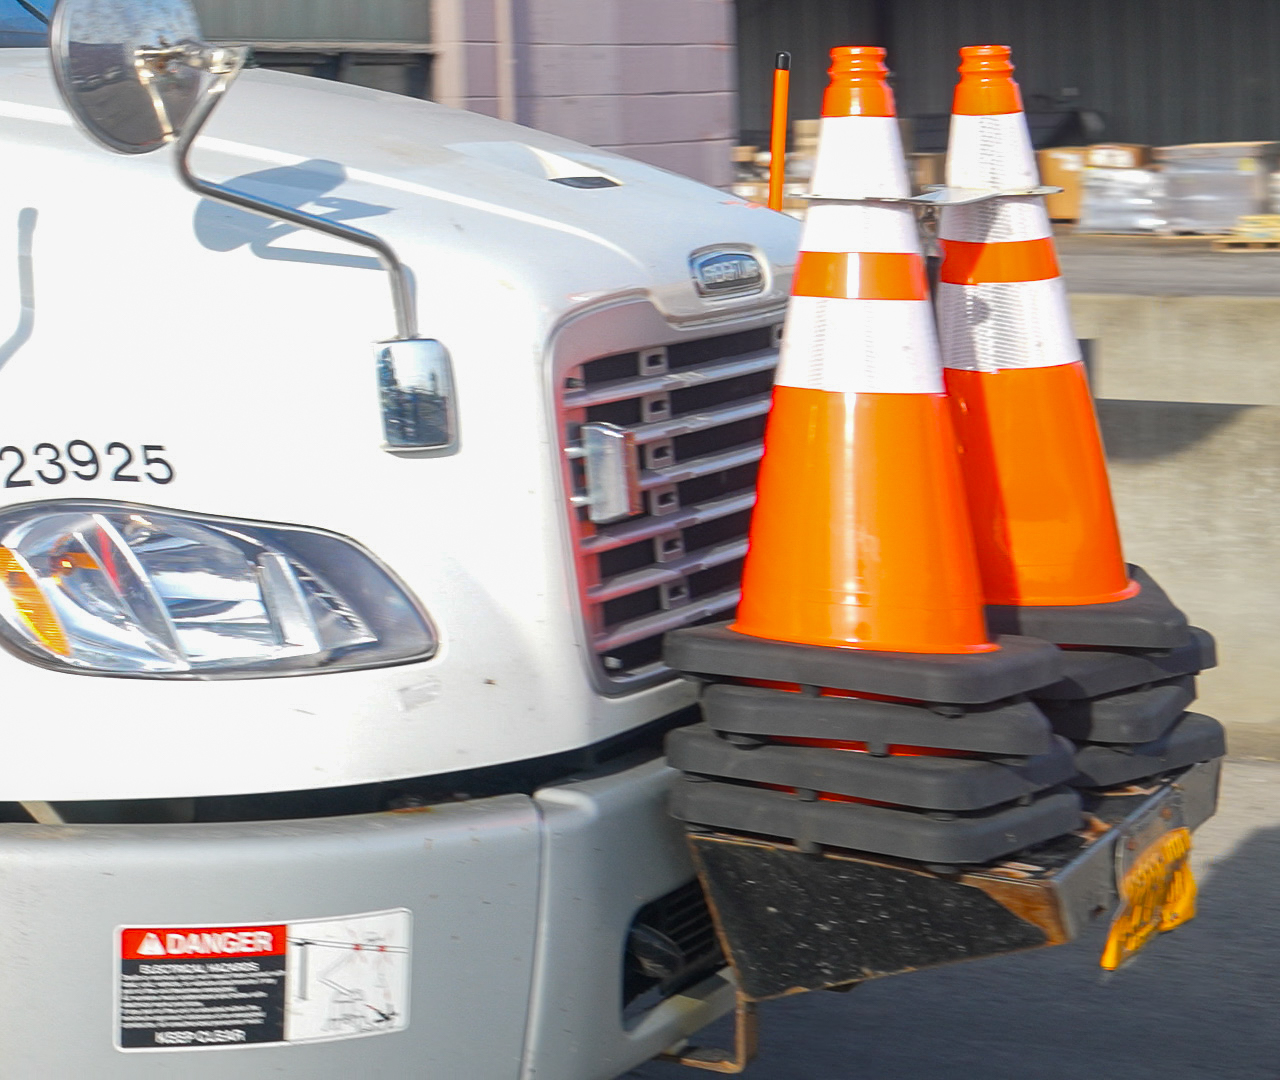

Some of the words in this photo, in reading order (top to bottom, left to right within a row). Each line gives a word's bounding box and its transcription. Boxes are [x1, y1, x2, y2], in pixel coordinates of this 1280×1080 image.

[166, 931, 274, 955] DANGER
[154, 1030, 195, 1045] KEEP
[194, 1028, 247, 1044] CLEAR
